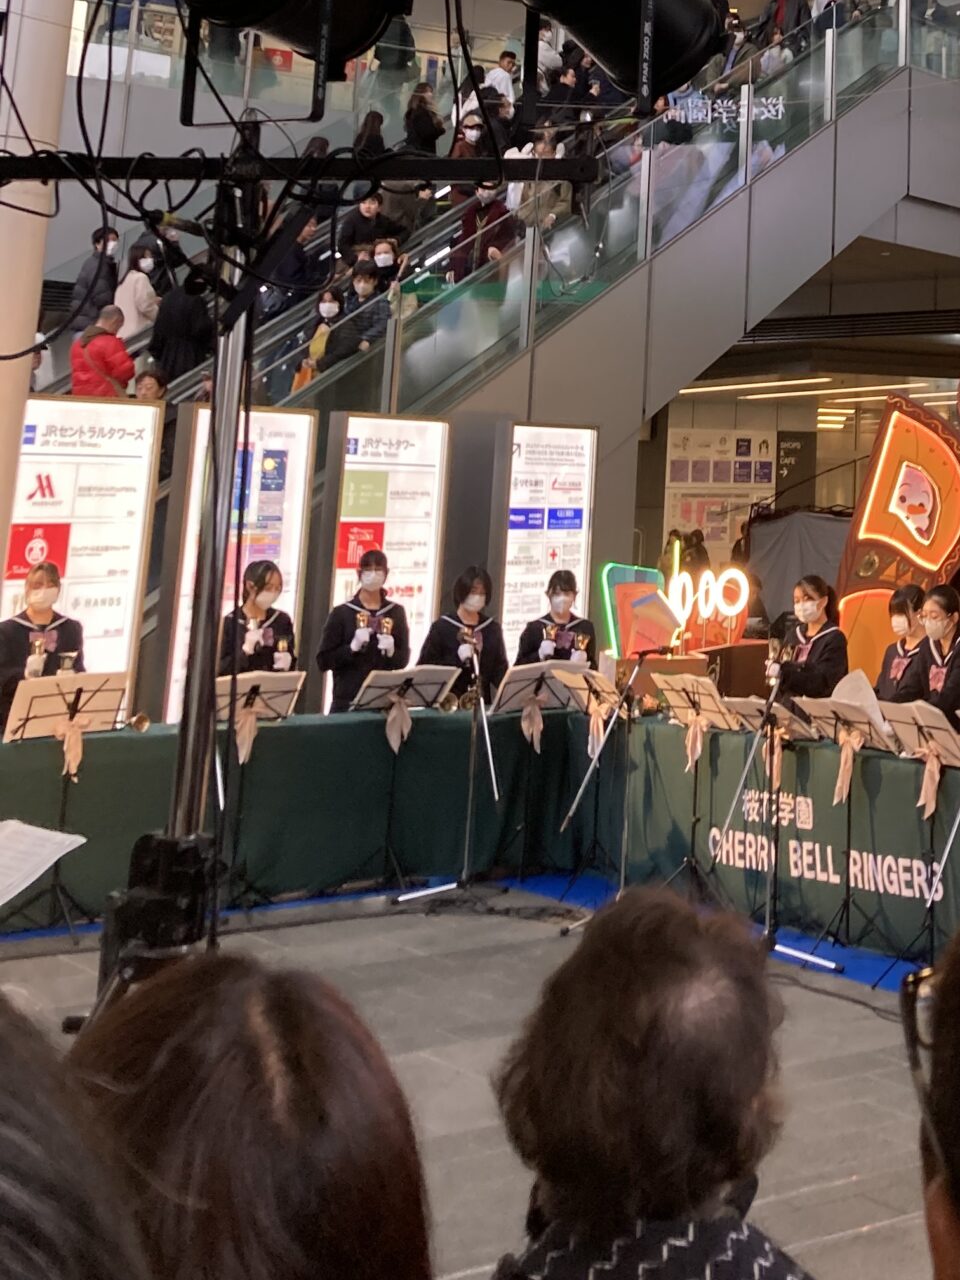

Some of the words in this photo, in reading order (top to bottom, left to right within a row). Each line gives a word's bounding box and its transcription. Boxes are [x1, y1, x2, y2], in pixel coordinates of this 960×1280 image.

[42, 424, 146, 441] JRセントラルタワーズ
[362, 437, 416, 451] JRゲートタワー
[84, 597, 122, 608] HANDS
[788, 839, 840, 884] BELL
